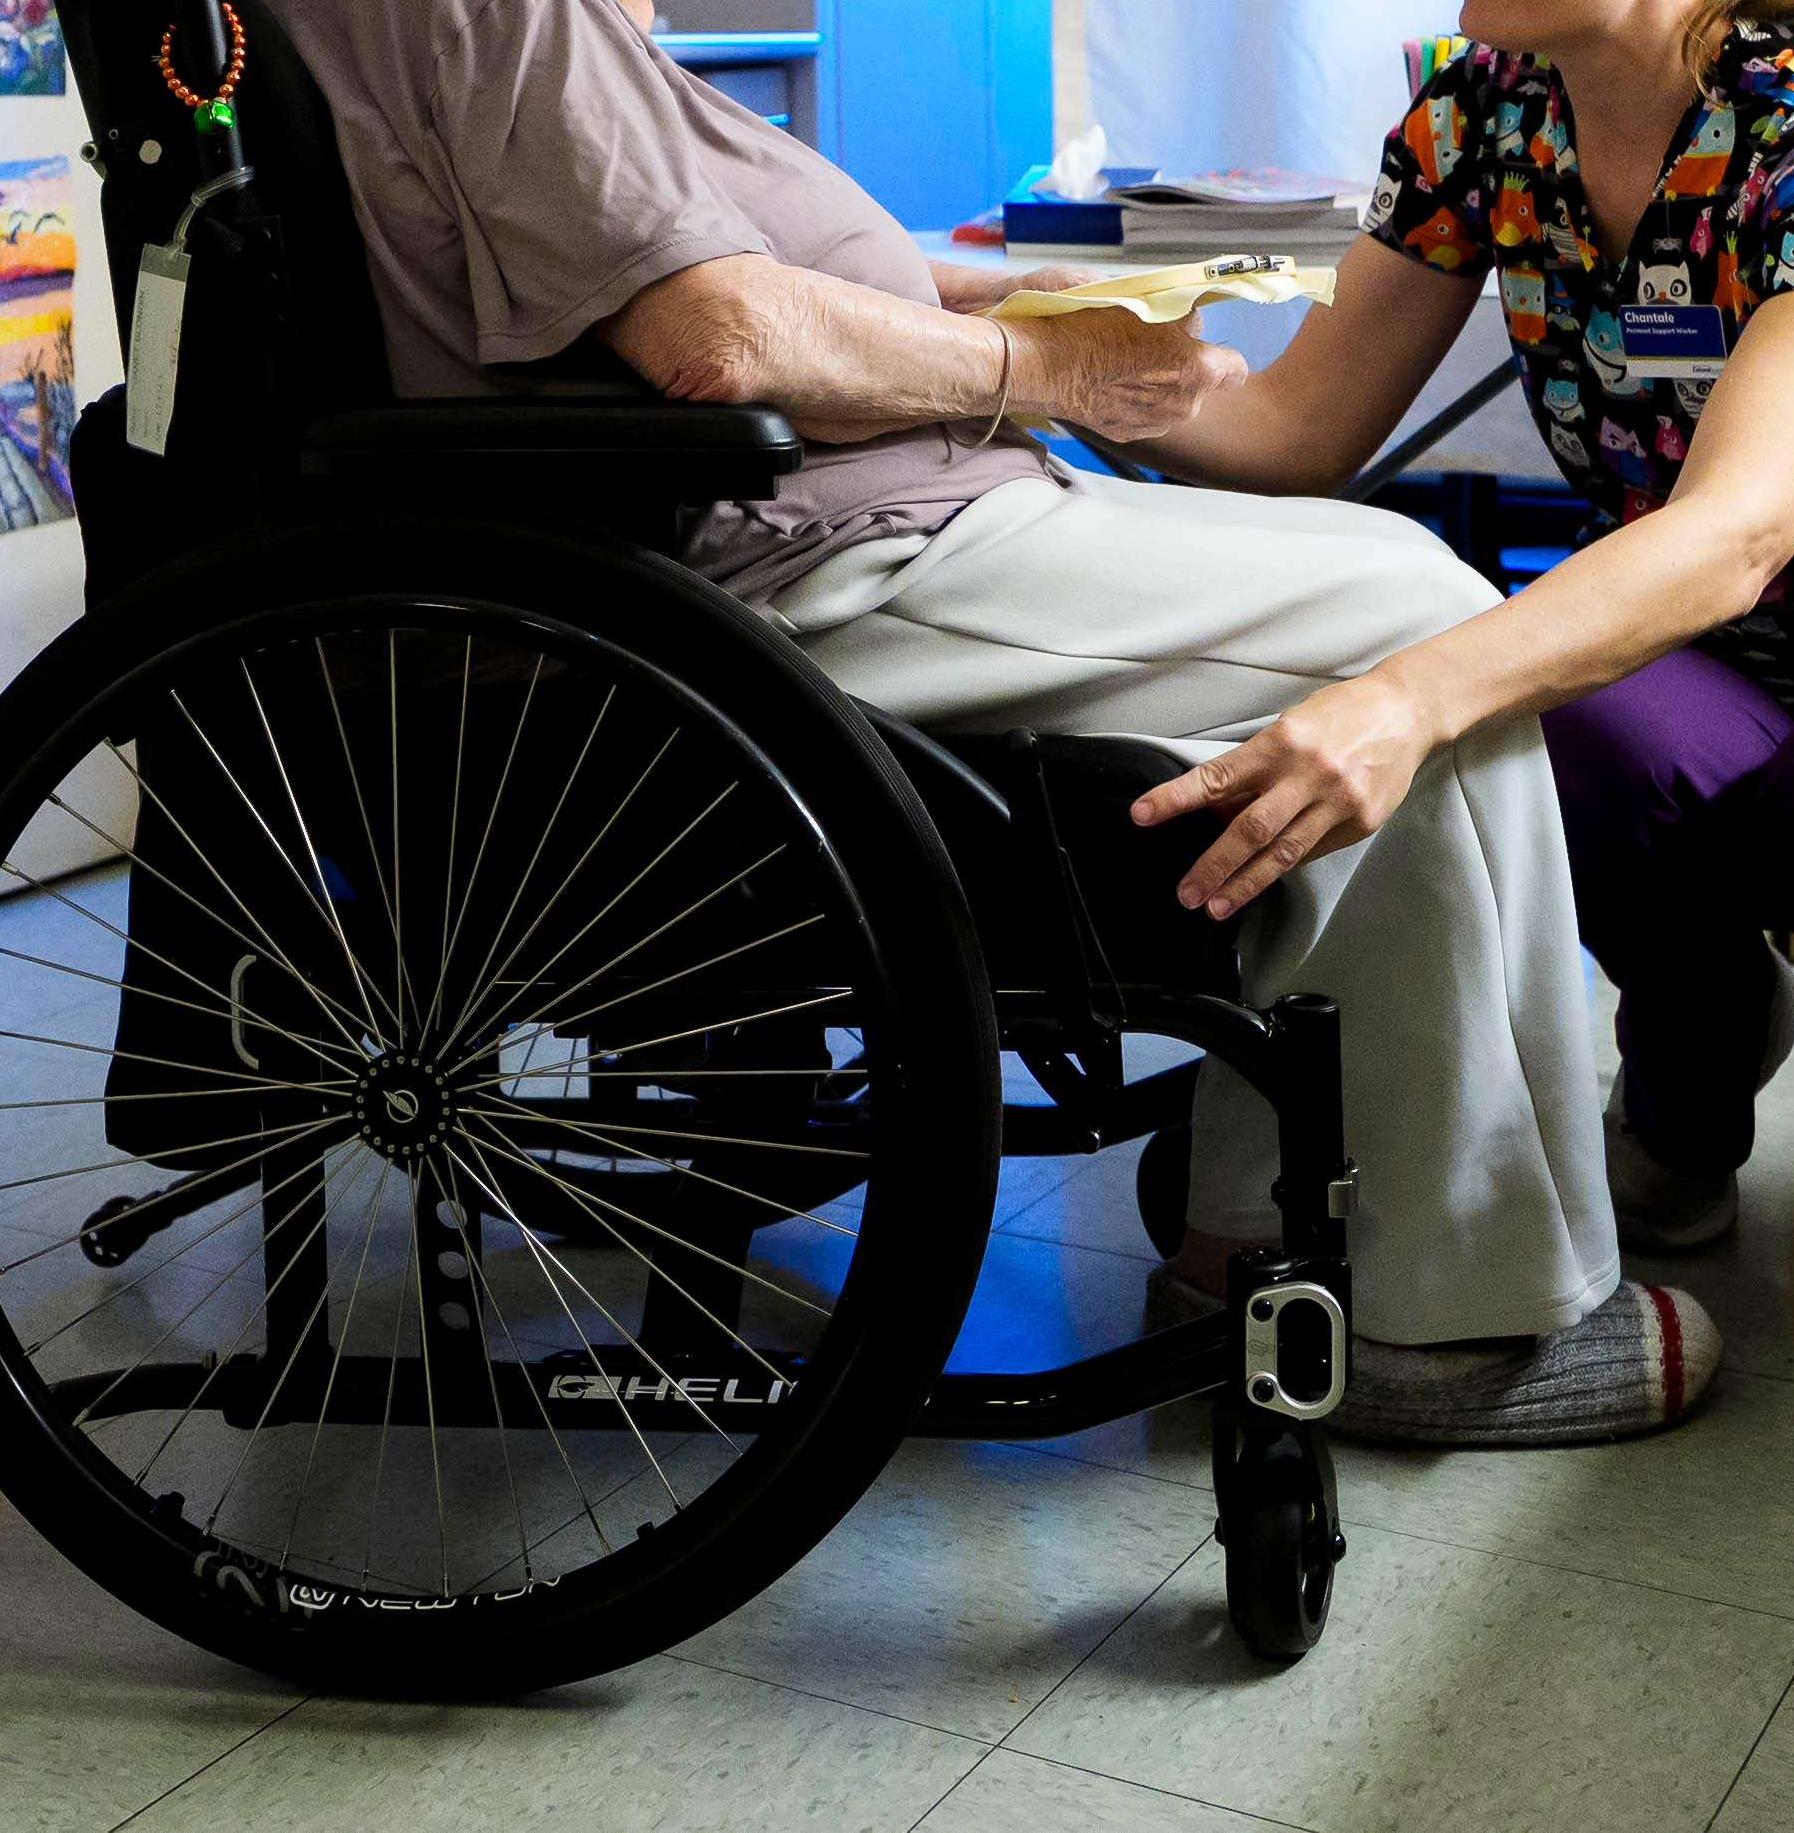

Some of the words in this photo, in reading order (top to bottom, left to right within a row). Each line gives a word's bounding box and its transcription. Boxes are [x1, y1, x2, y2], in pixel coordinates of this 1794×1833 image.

[1624, 311, 1675, 324] Chantale
[1652, 328, 1676, 336] Support
[623, 1375, 799, 1404] HELI
